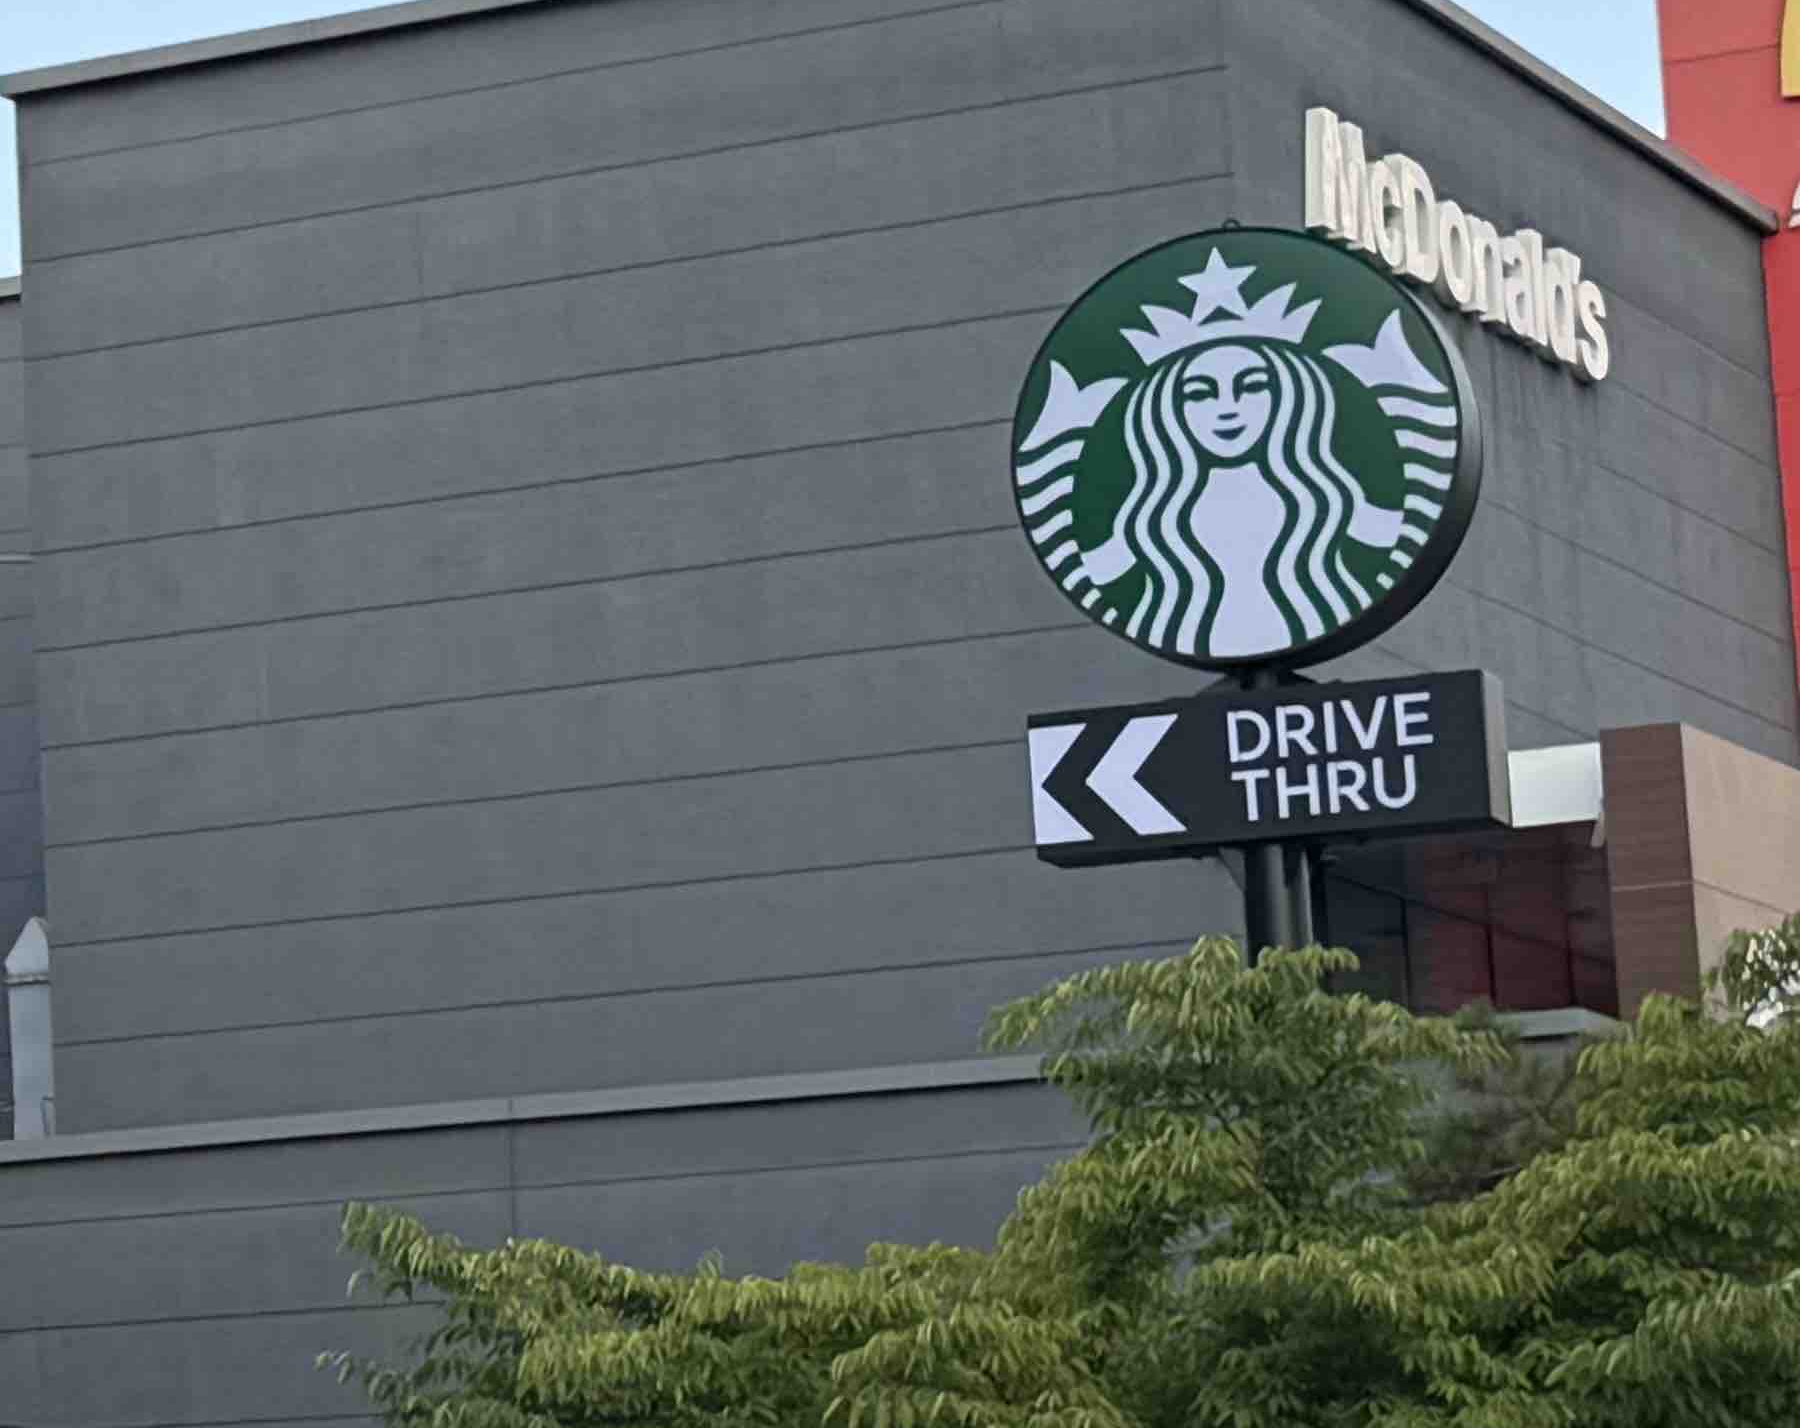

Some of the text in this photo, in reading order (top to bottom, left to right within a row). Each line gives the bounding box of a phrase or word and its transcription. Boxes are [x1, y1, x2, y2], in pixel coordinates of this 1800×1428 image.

[1303, 107, 1611, 383] McDonald's
[1226, 690, 1435, 764] DRIVE
[1230, 753, 1418, 823] THRU
